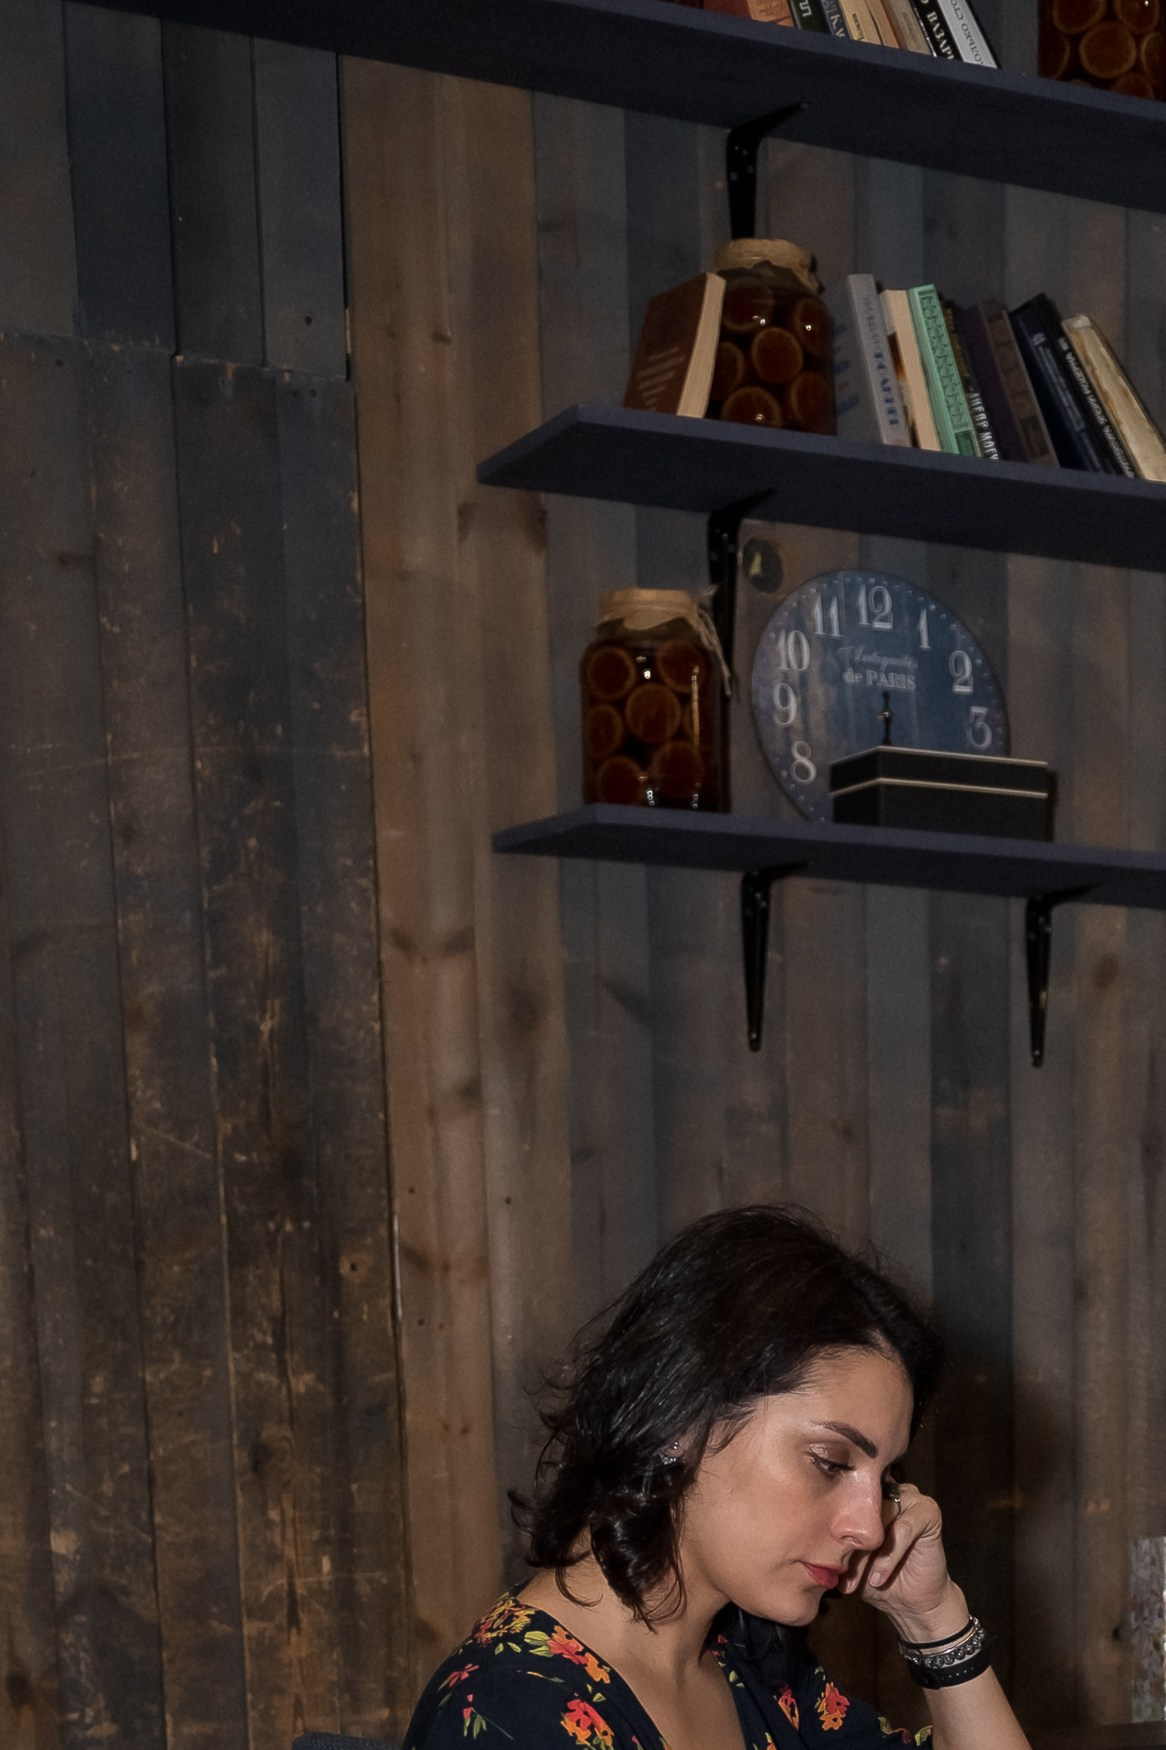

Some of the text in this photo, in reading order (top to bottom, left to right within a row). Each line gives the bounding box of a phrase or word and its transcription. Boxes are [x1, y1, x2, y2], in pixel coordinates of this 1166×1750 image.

[812, 590, 844, 638] 11
[857, 583, 893, 630] 12
[916, 607, 932, 650] 1
[777, 627, 811, 672] 10
[949, 650, 974, 694] 2
[772, 682, 798, 726] 9
[965, 705, 993, 749] 3
[790, 740, 817, 783] 8
